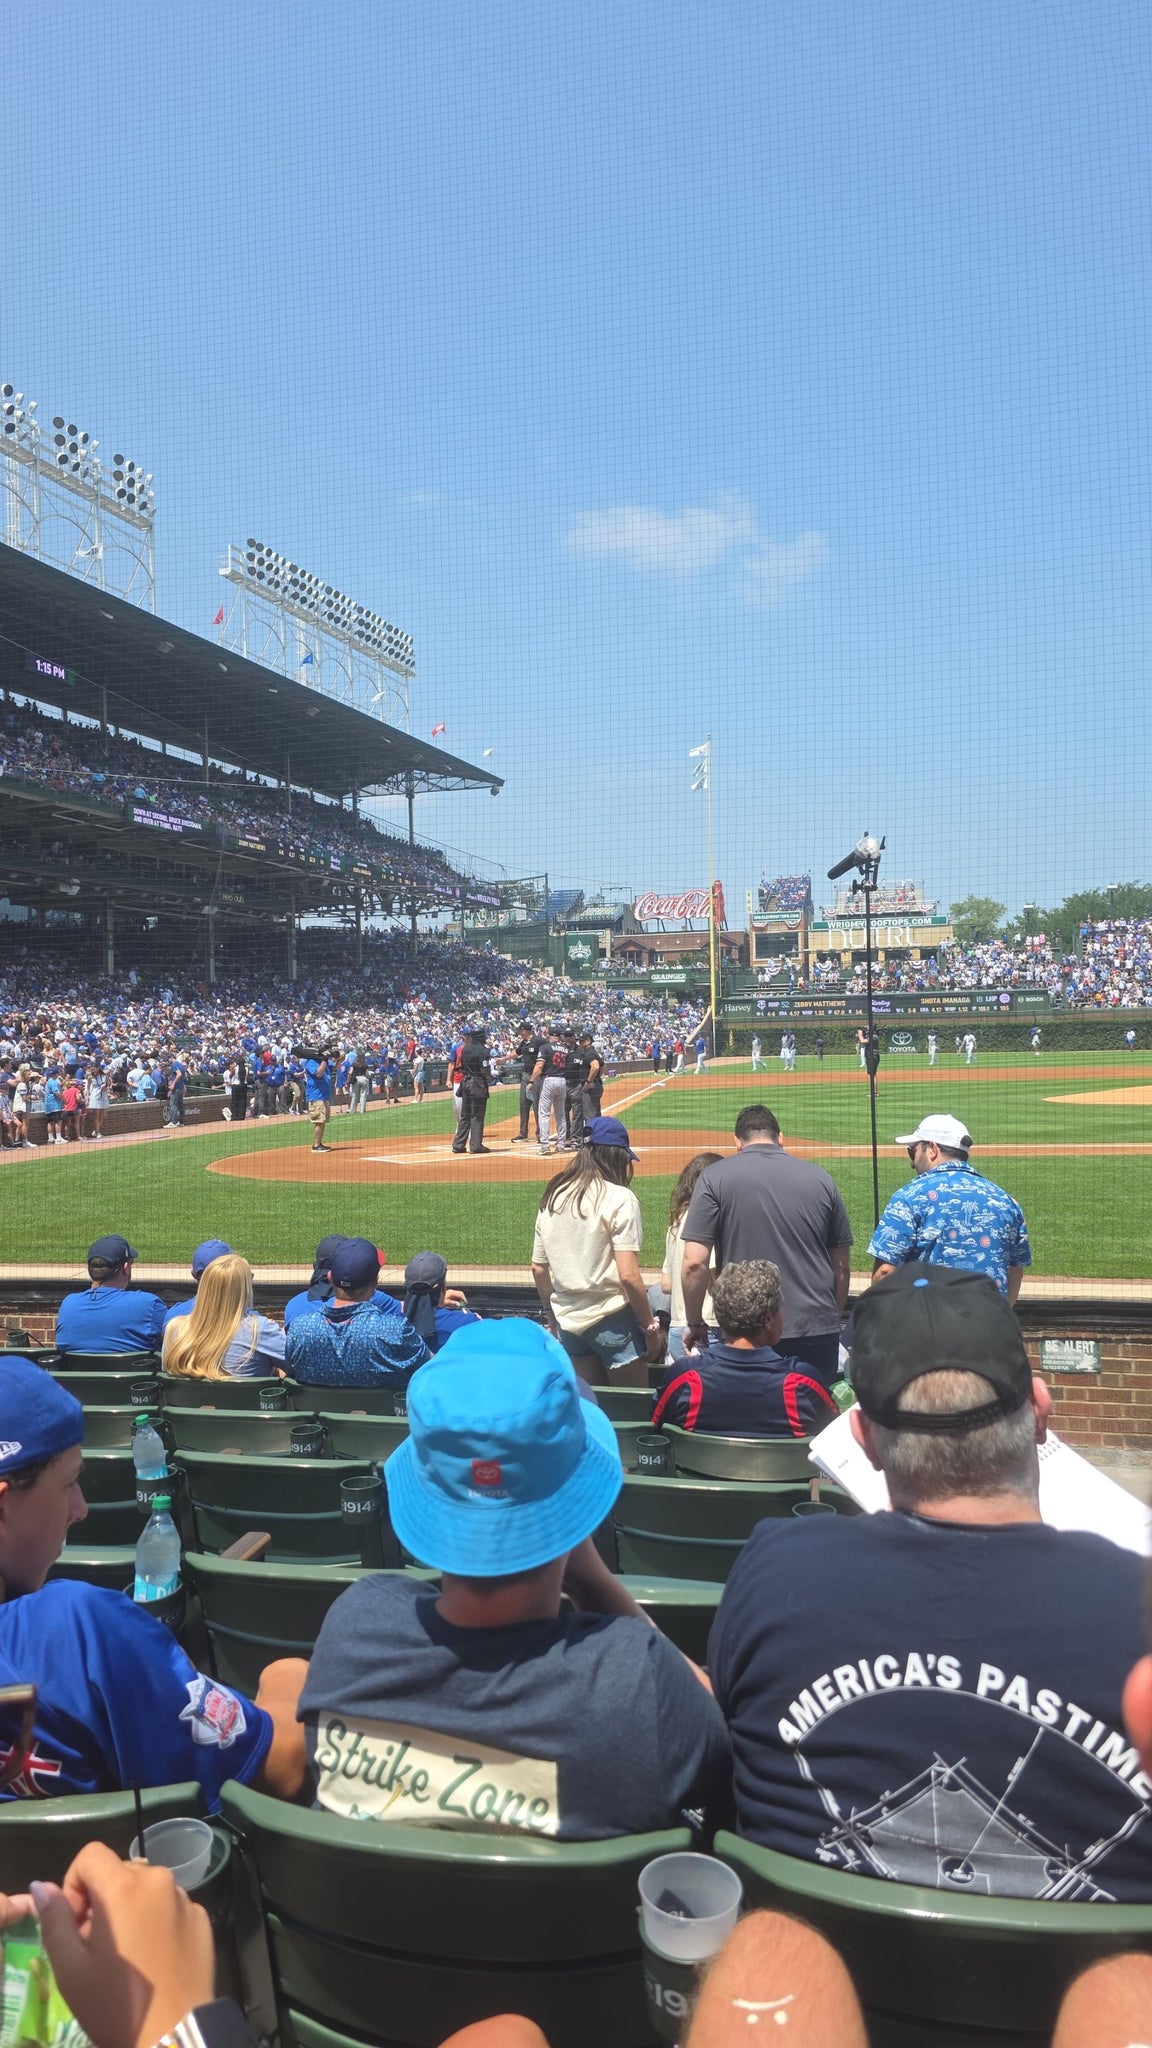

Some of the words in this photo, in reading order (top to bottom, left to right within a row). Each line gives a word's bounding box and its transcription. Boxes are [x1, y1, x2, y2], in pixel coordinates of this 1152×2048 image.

[36, 659, 52, 675] 1:15
[53, 665, 65, 680] PM
[634, 889, 713, 922] Coca-Cola
[651, 973, 687, 981] GRAINGER
[920, 997, 941, 1005] SHOTA
[941, 996, 971, 1004] IMANAGA
[724, 1003, 751, 1013] Harvey
[1045, 1339, 1059, 1352] BE
[1064, 1340, 1096, 1353] ALERT
[291, 1443, 312, 1453] 1914
[638, 1454, 661, 1465] 1914
[468, 1489, 510, 1497] TOYOTA
[343, 1501, 372, 1514] 1914
[777, 1651, 963, 1745] AMERICA'S
[317, 1718, 430, 1803] Strike
[437, 1753, 550, 1830] Zone
